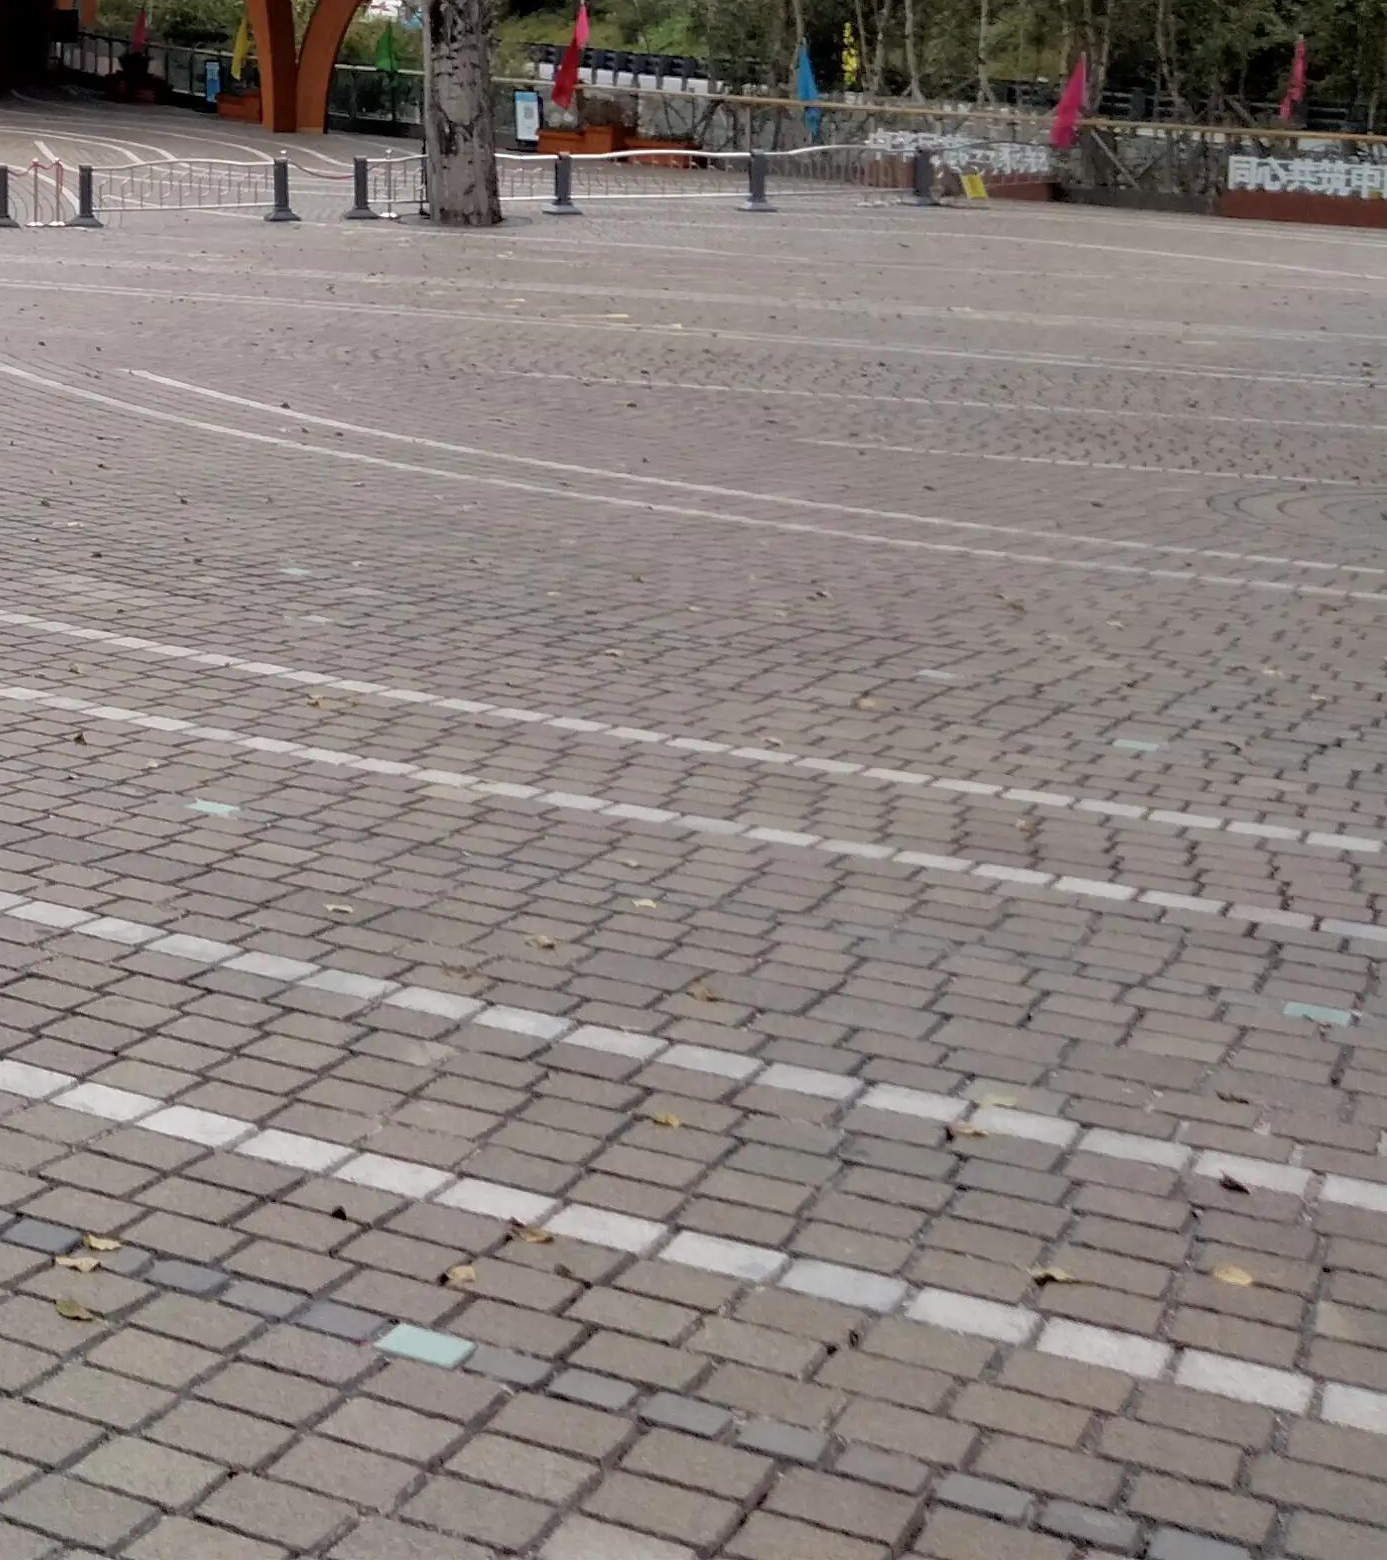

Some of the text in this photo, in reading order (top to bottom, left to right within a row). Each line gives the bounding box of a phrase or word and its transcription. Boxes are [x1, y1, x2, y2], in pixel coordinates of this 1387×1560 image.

[1228, 155, 1387, 200] 同心共筑中
